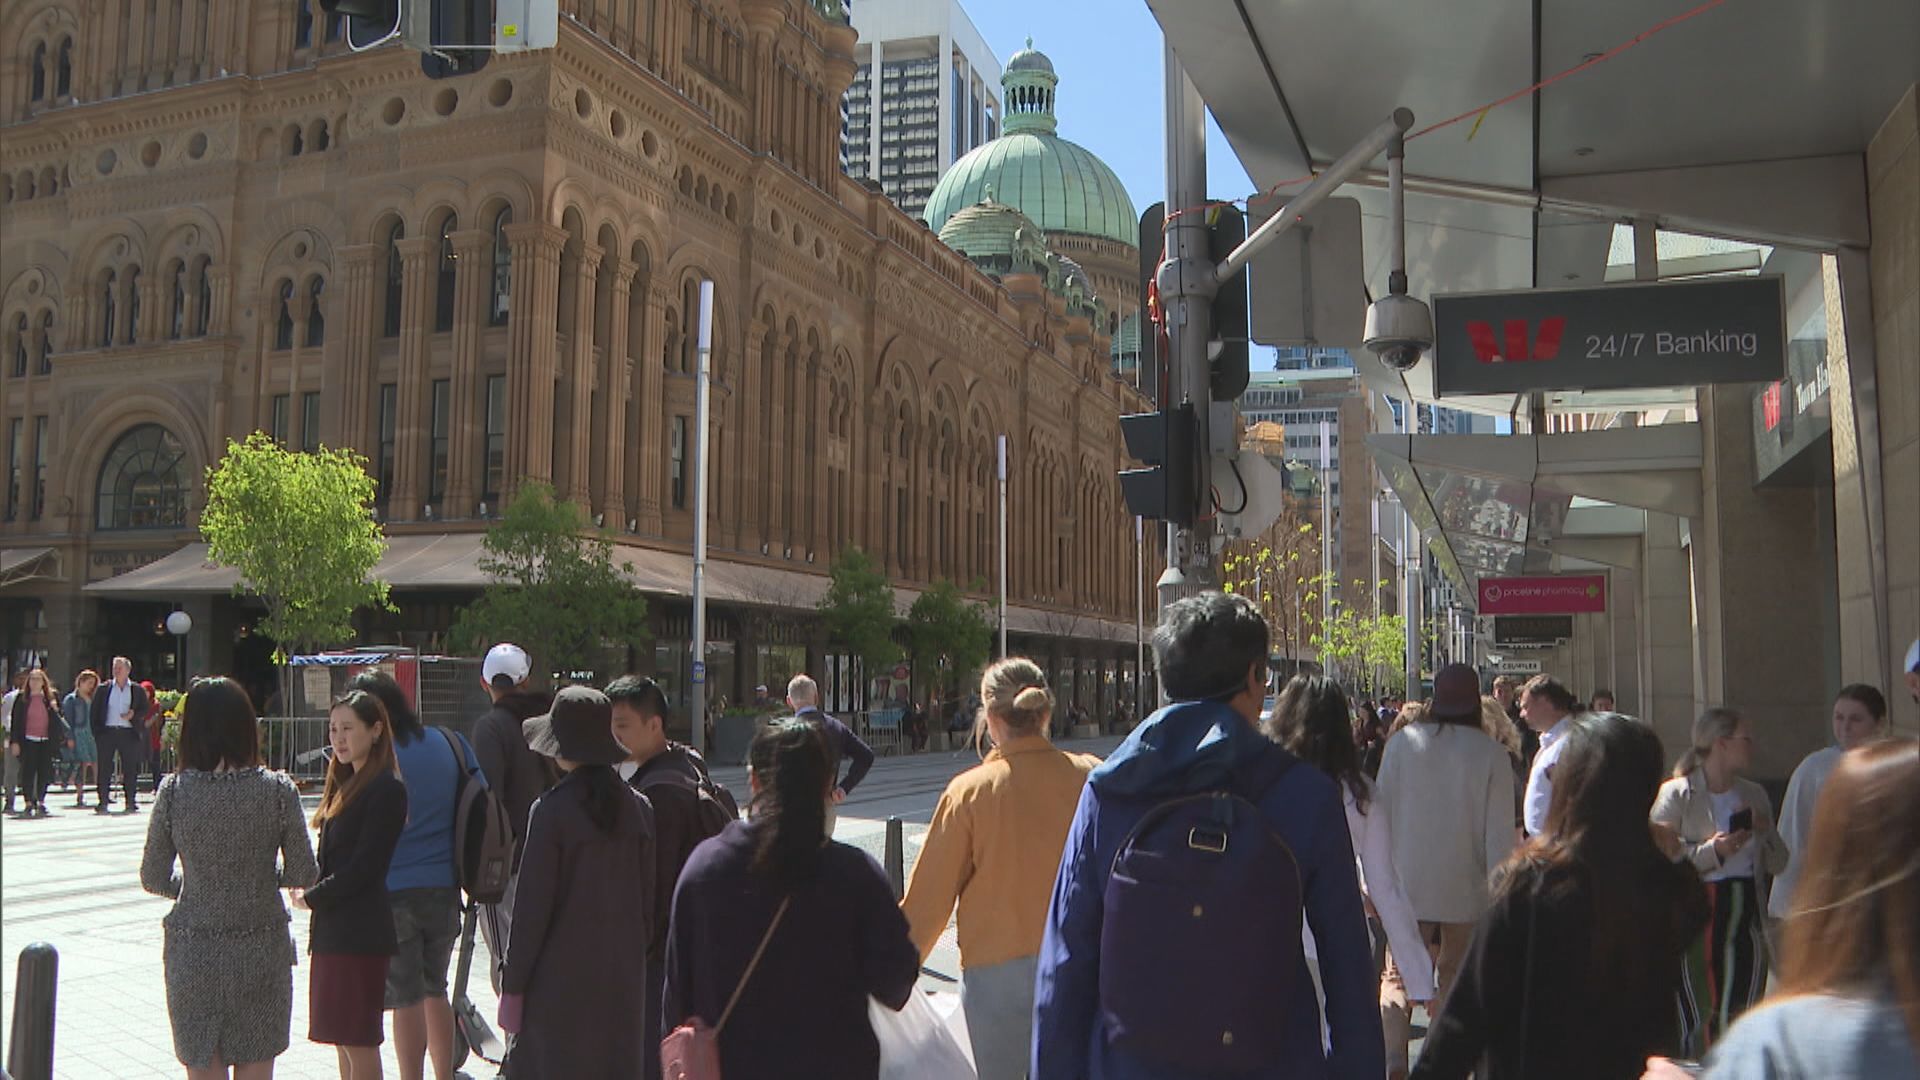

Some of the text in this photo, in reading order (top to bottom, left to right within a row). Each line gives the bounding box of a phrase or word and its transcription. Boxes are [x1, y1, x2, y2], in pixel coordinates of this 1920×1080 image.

[1585, 333, 1645, 359] 24/7
[1656, 328, 1757, 356] Banking
[1796, 381, 1816, 415] Town
[1503, 585, 1585, 598] priceline pharmacy
